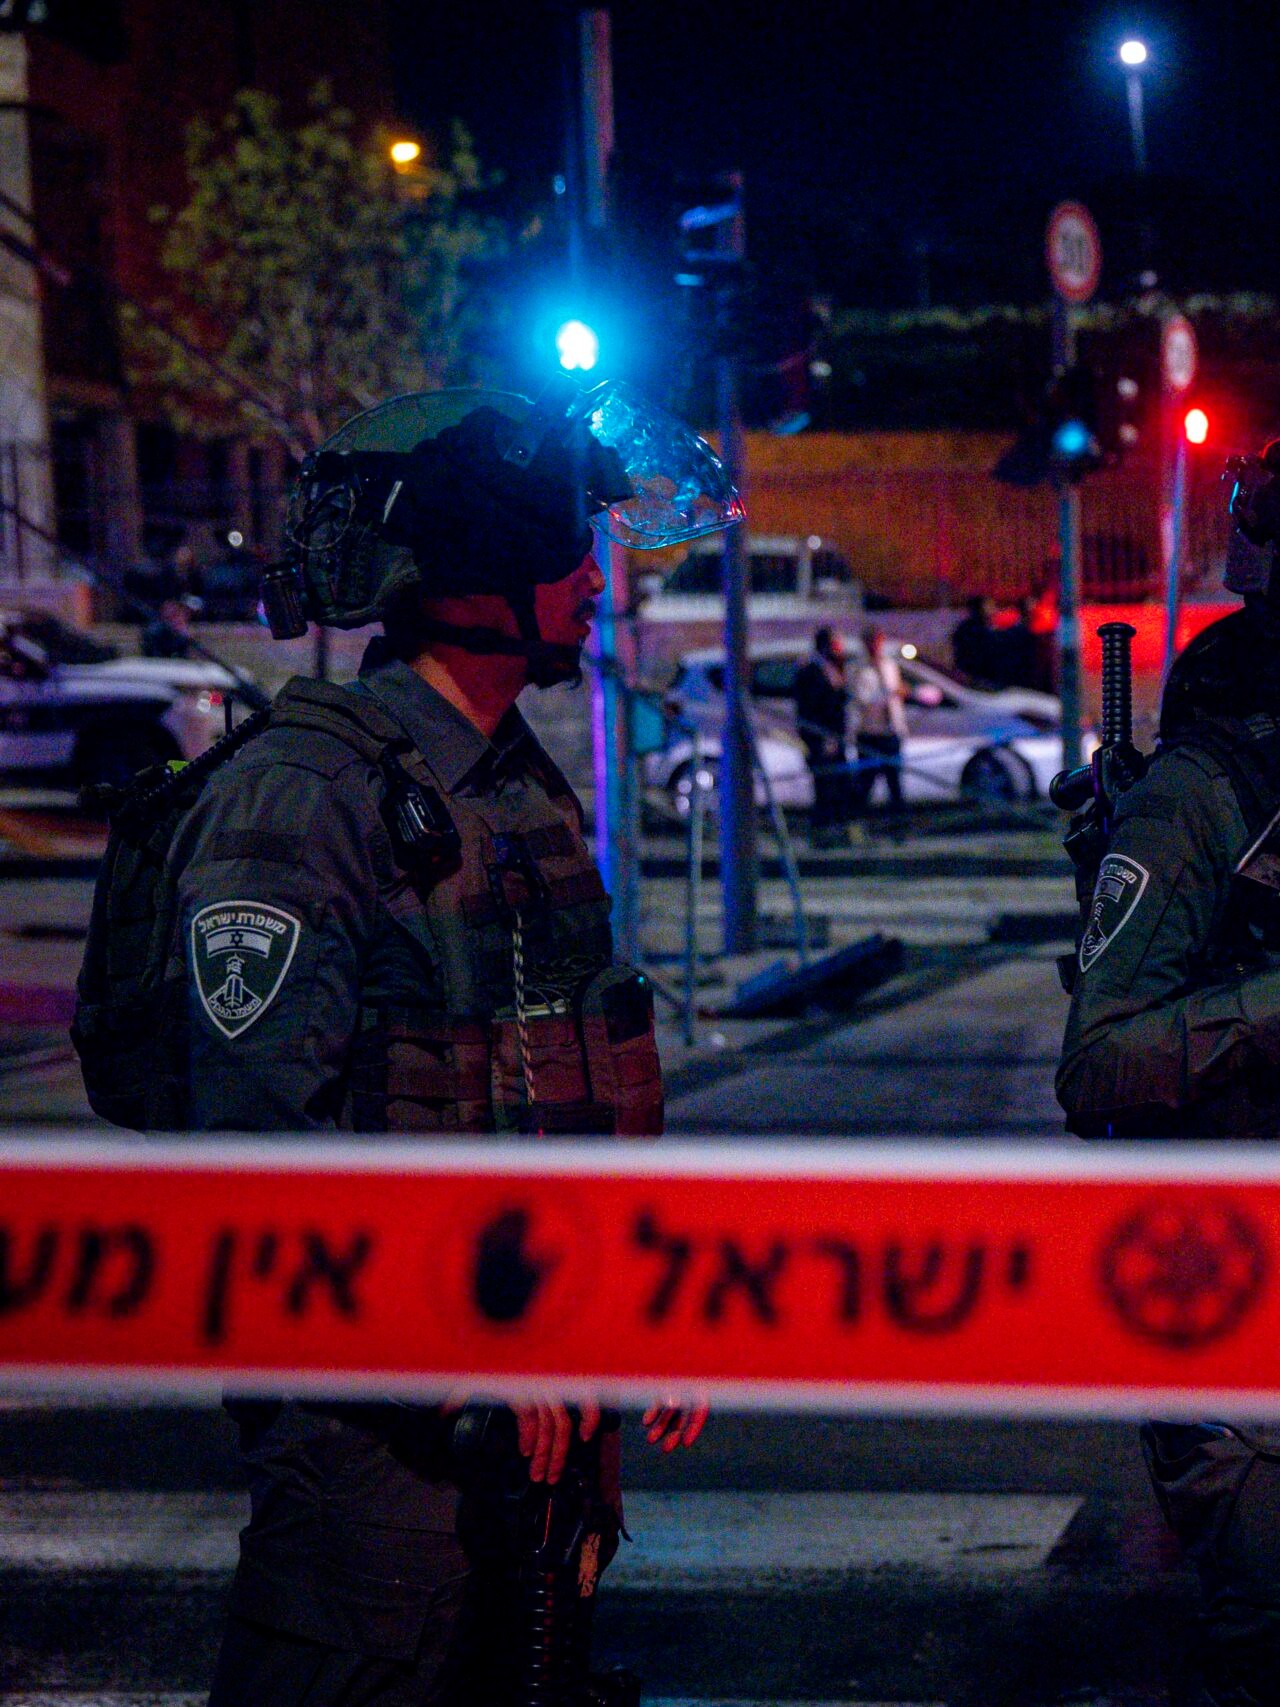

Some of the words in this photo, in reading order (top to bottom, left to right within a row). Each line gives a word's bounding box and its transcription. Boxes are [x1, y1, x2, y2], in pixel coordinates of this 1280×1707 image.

[197, 911, 236, 934] ישראל
[235, 912, 288, 935] משטרת
[0, 1218, 160, 1322] מע
[202, 1220, 373, 1347] אין
[630, 1207, 1032, 1335] ישראל
